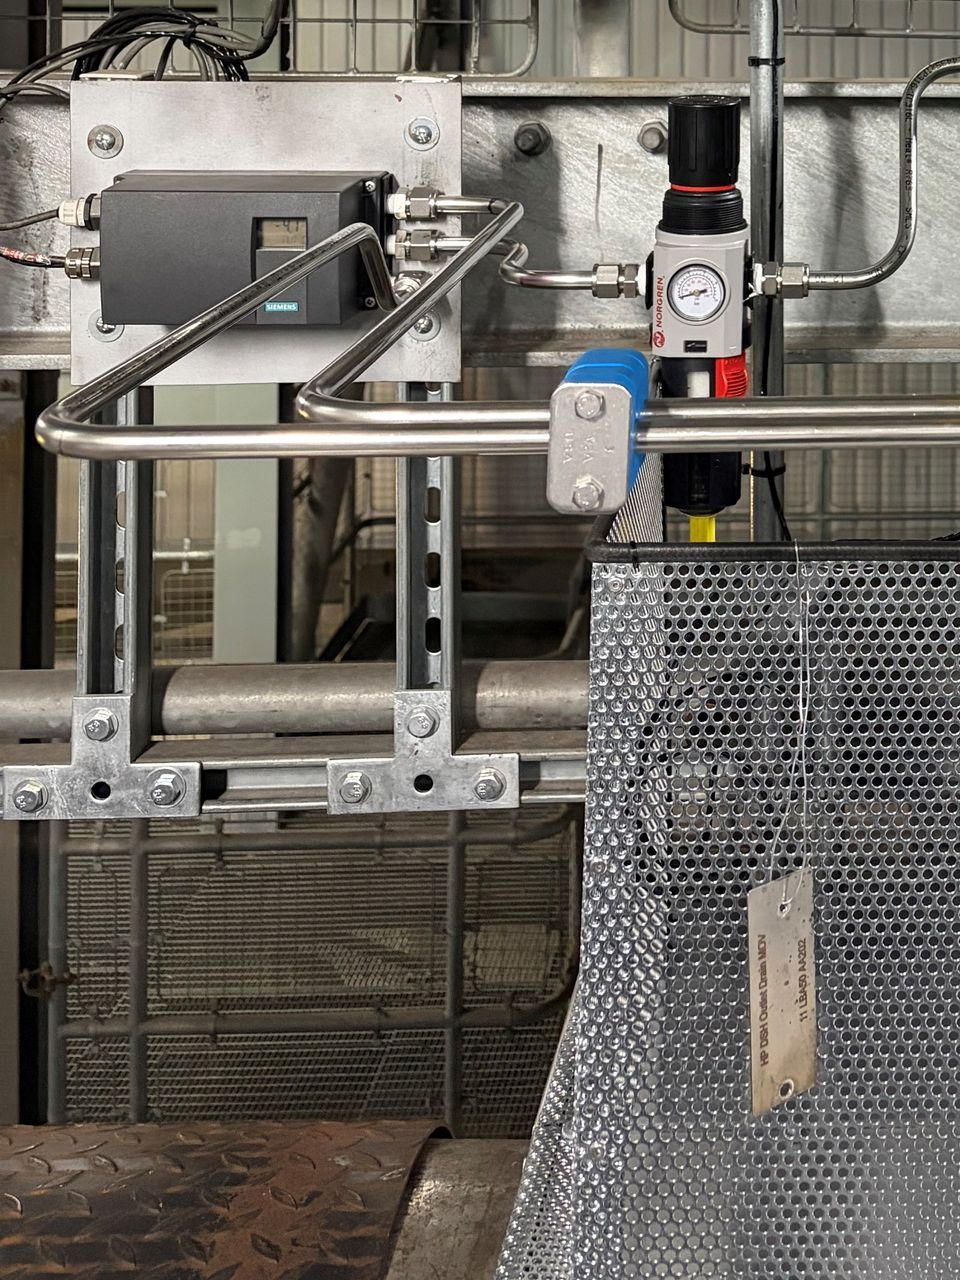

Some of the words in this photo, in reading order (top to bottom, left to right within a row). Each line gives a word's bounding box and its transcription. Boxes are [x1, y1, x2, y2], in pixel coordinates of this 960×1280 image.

[265, 302, 298, 311] SIEMENS
[656, 276, 664, 328] NORGREN
[757, 934, 767, 960] MOV
[797, 938, 807, 972] AA202
[758, 960, 768, 989] Drain
[759, 989, 768, 1021] Outlet
[760, 1050, 769, 1067] HP
